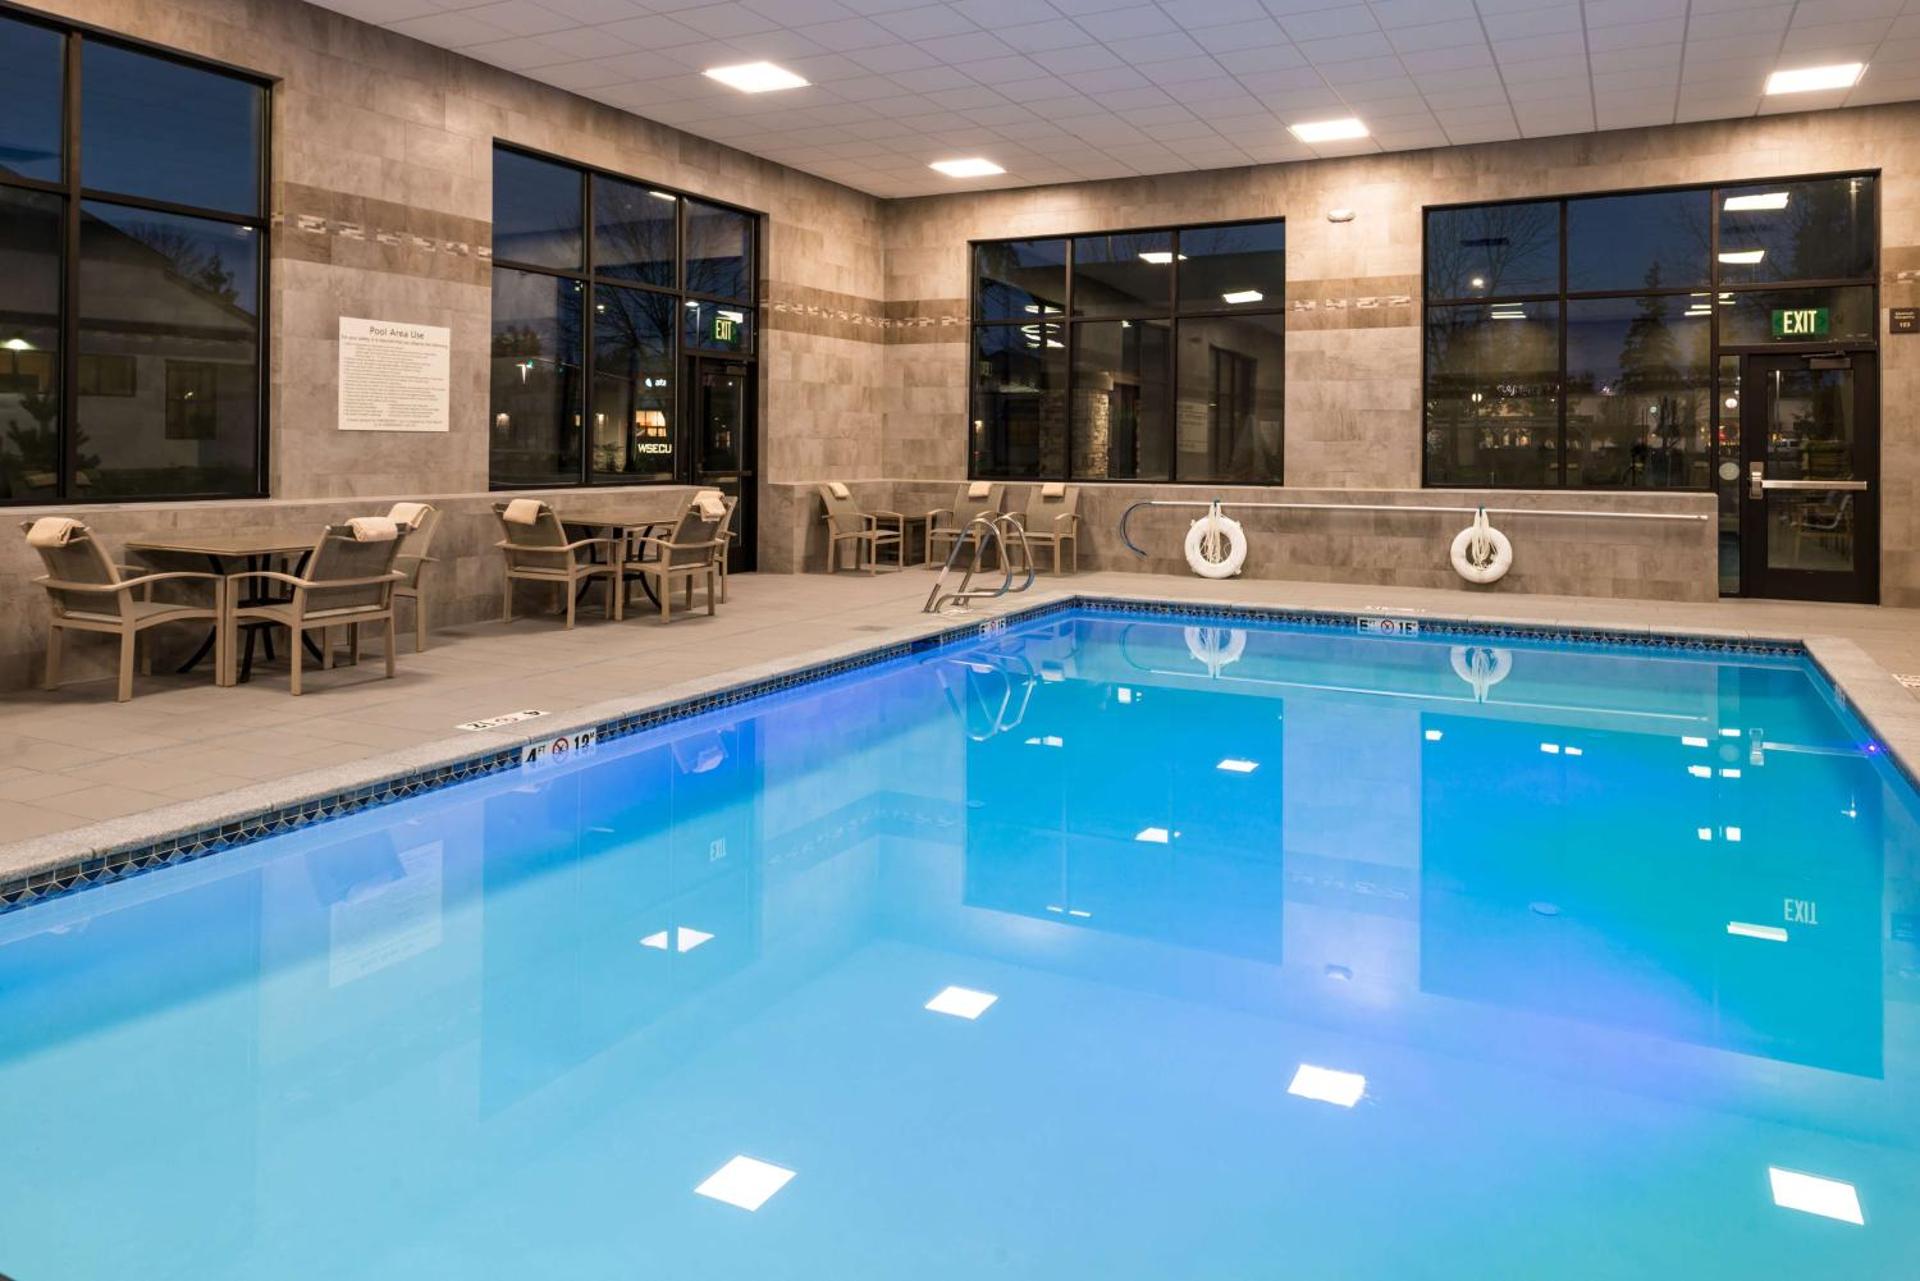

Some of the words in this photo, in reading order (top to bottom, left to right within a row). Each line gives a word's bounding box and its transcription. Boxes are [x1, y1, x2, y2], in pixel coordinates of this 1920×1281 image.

[716, 319, 732, 341] EXIT
[1783, 310, 1818, 334] EXIT
[369, 326, 387, 336] Pool
[390, 329, 408, 339] Area
[411, 331, 425, 340] Use
[637, 443, 672, 454] WSECU
